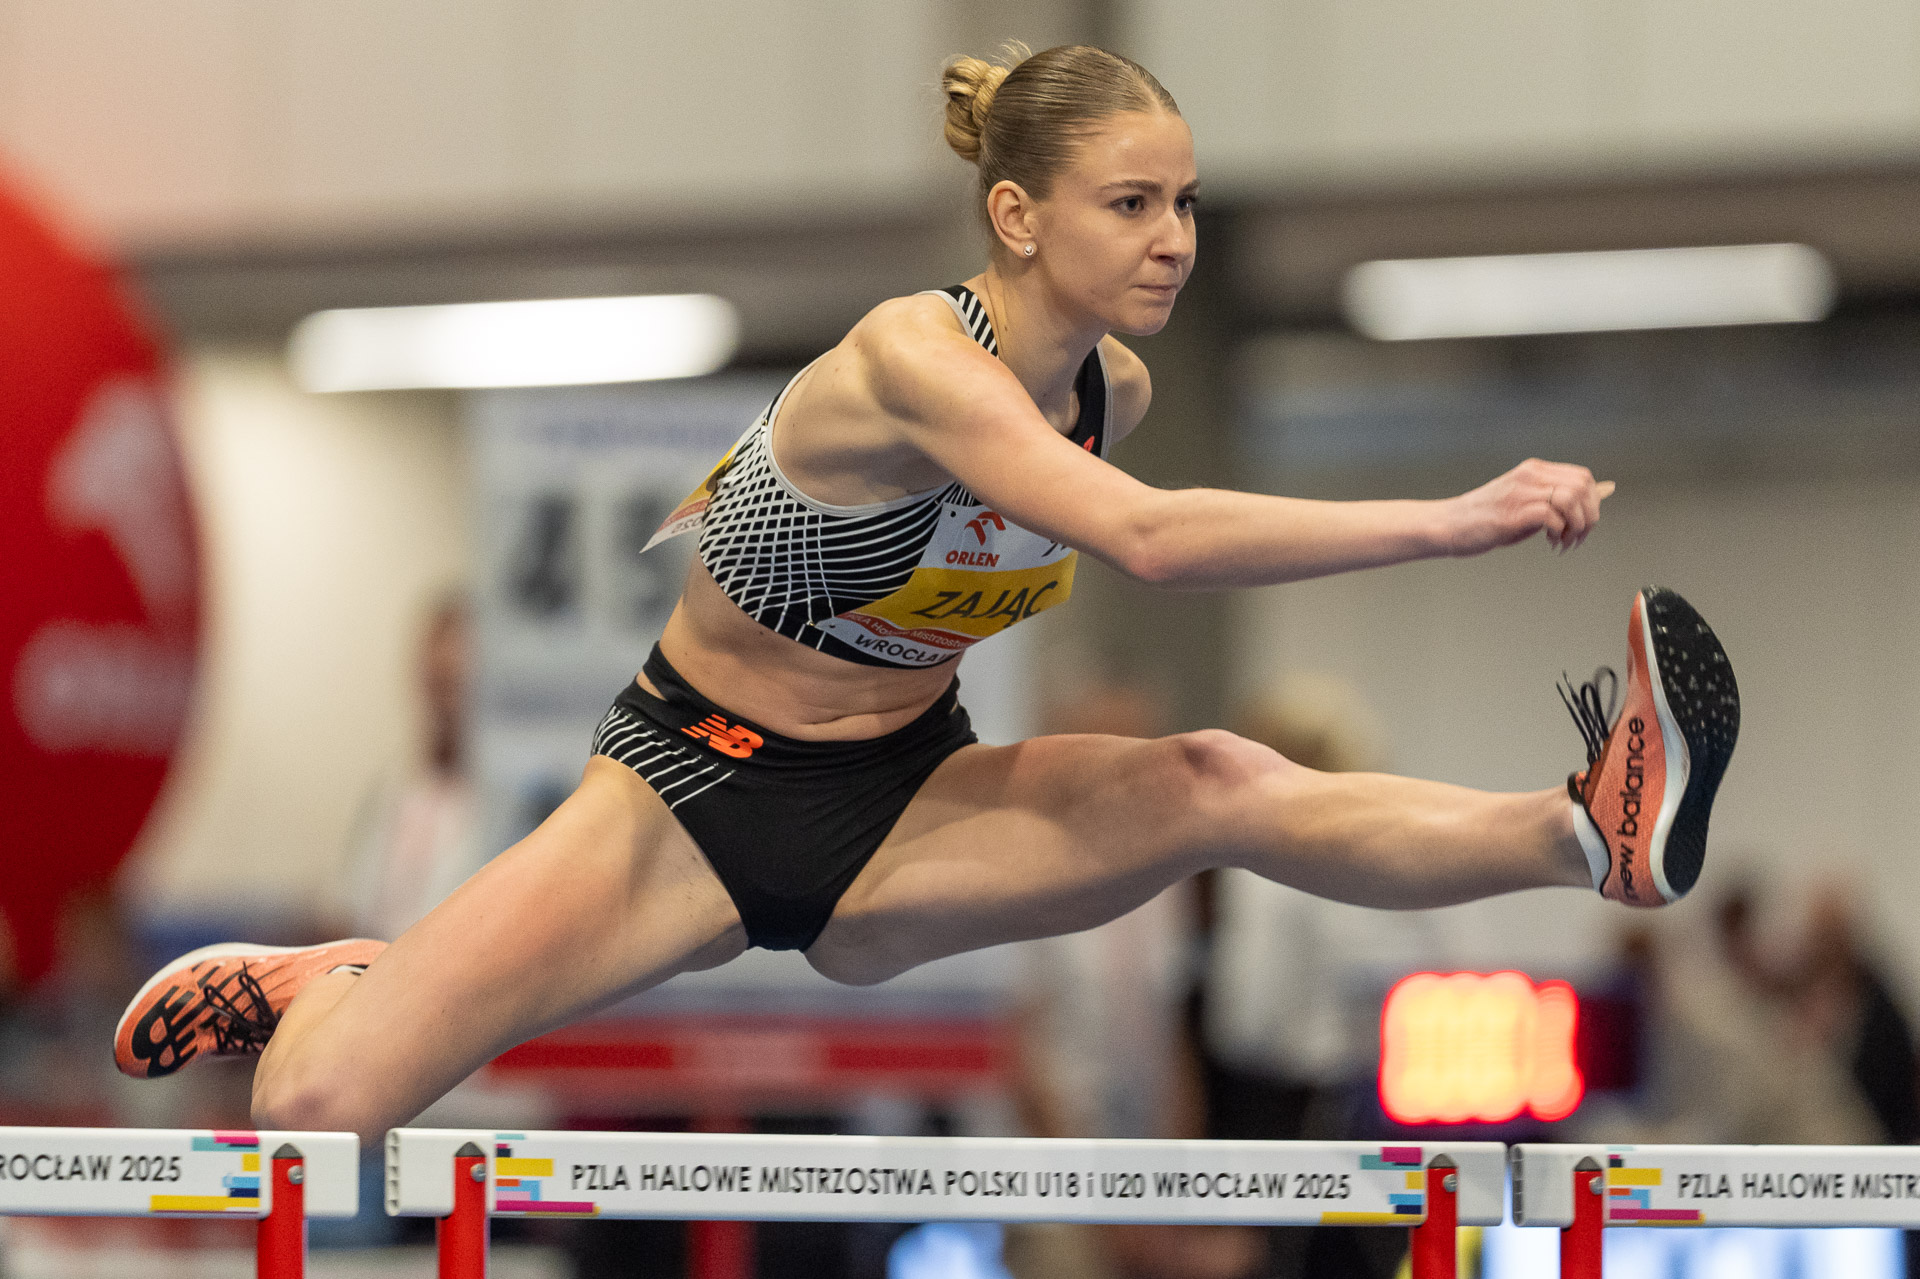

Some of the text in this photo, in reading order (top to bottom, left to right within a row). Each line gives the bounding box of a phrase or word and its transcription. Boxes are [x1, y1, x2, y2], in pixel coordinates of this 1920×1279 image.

[945, 549, 1000, 568] ORLEN
[910, 580, 1059, 629] ZAJĄC
[1617, 716, 1645, 900] new balance
[120, 1155, 182, 1182] 2025
[571, 1164, 1352, 1200] PZLA HALOWE MISTRZOSTWA POLSKI U18 i U20 WROCŁAW 2025
[1678, 1172, 1920, 1200] PZLA HALOWE MISTR
